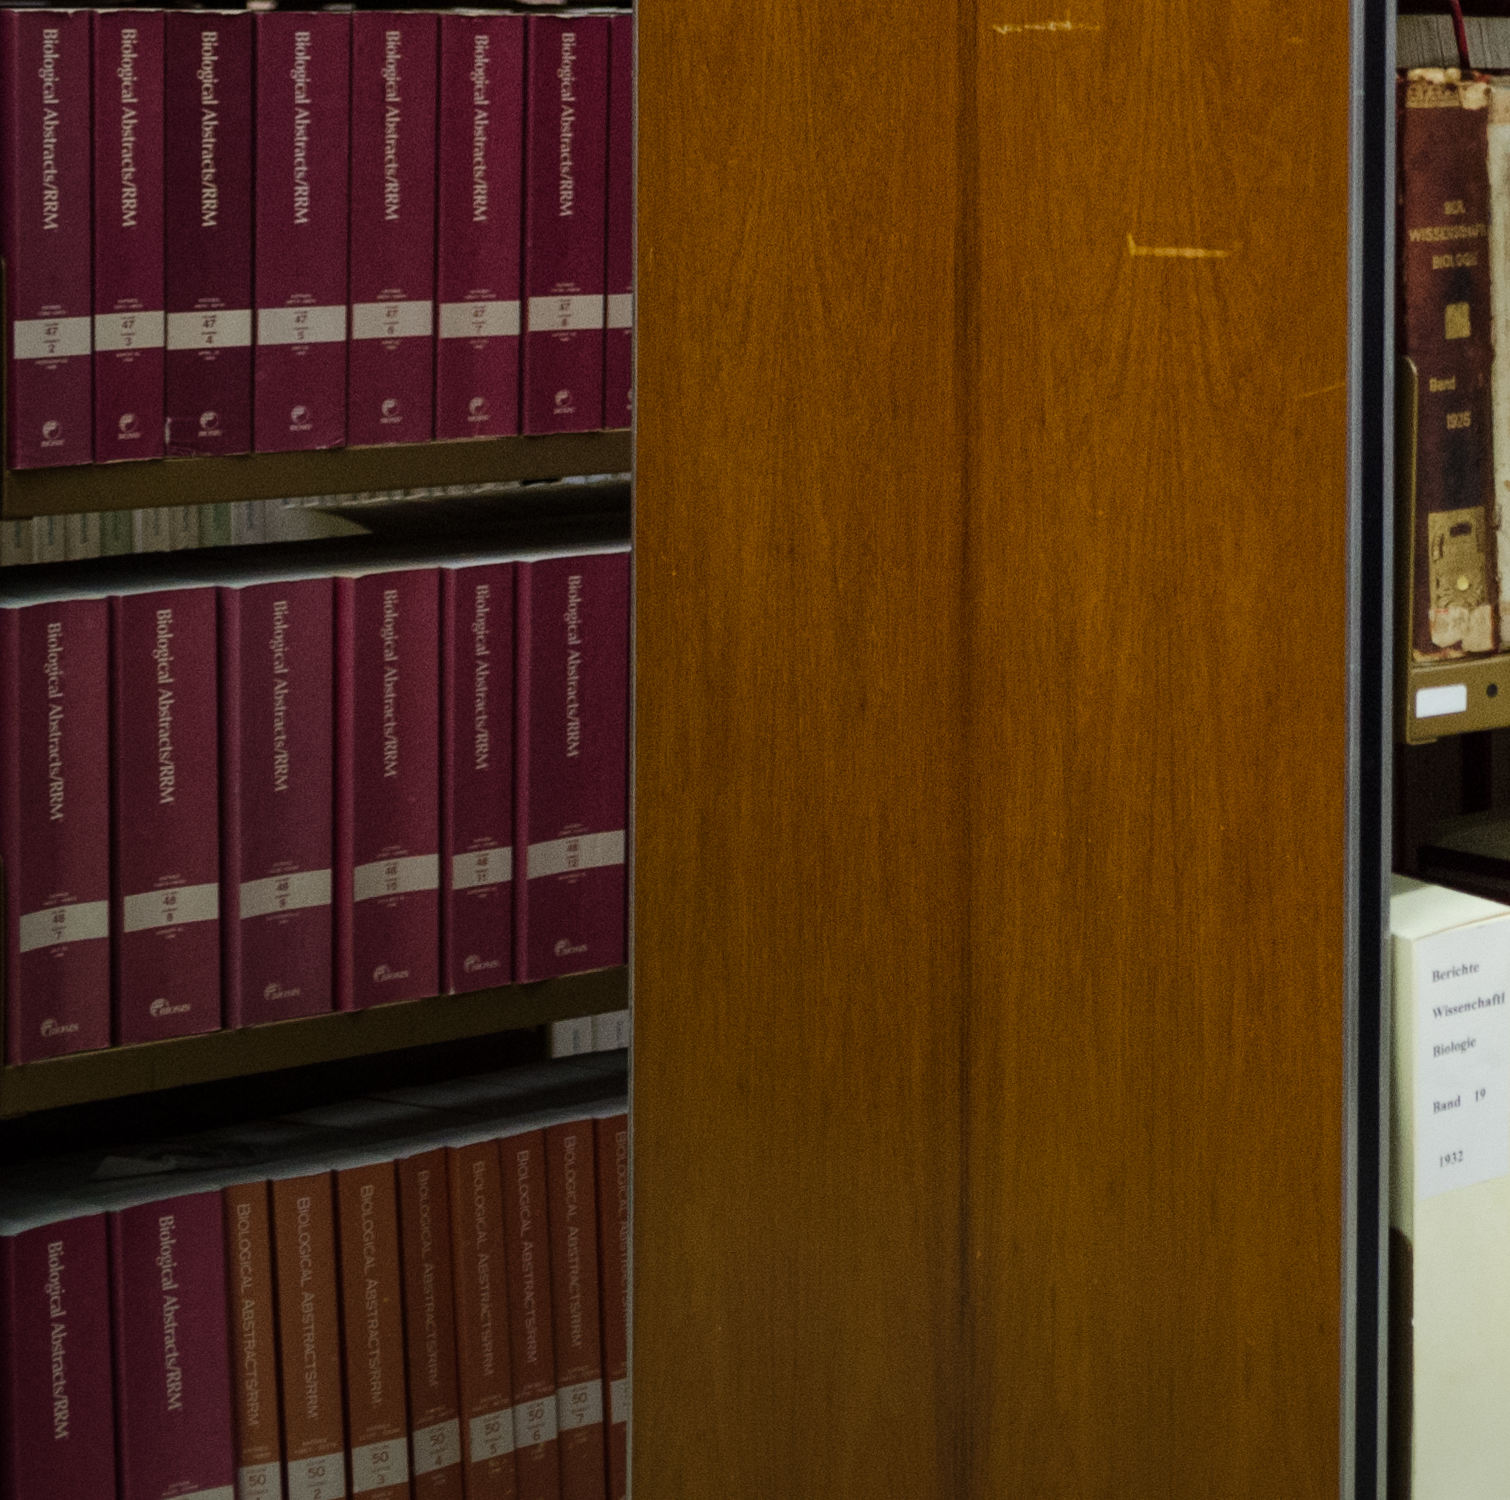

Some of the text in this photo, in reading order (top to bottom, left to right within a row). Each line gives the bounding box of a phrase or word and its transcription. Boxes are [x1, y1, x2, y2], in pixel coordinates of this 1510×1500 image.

[37, 26, 61, 232] Biological Abstracts/RRM
[115, 26, 140, 229] Biological Abstracts/RRM
[195, 29, 221, 228] Biological Abstracts/RRM
[288, 29, 313, 225] Biological Abstracts/RRM
[468, 33, 492, 223] Biological Abstracts/RRM
[121, 320, 135, 330] 47
[202, 319, 216, 329] 47
[42, 621, 65, 821] Biological Abstracts/RRM
[150, 607, 177, 804] Biological Abstracts/RRM
[378, 588, 400, 778] Biological Abstracts/RRM
[1431, 963, 1480, 983] Berichte
[1432, 991, 1506, 1019] Wissenchaftl
[1432, 1037, 1477, 1058] Biologie
[1432, 1088, 1486, 1114] Band 19
[1439, 1149, 1464, 1168] 1932
[154, 1213, 184, 1412] Biological Abstracts/RRM
[307, 1466, 326, 1479] 50
[372, 1451, 390, 1463] 50
